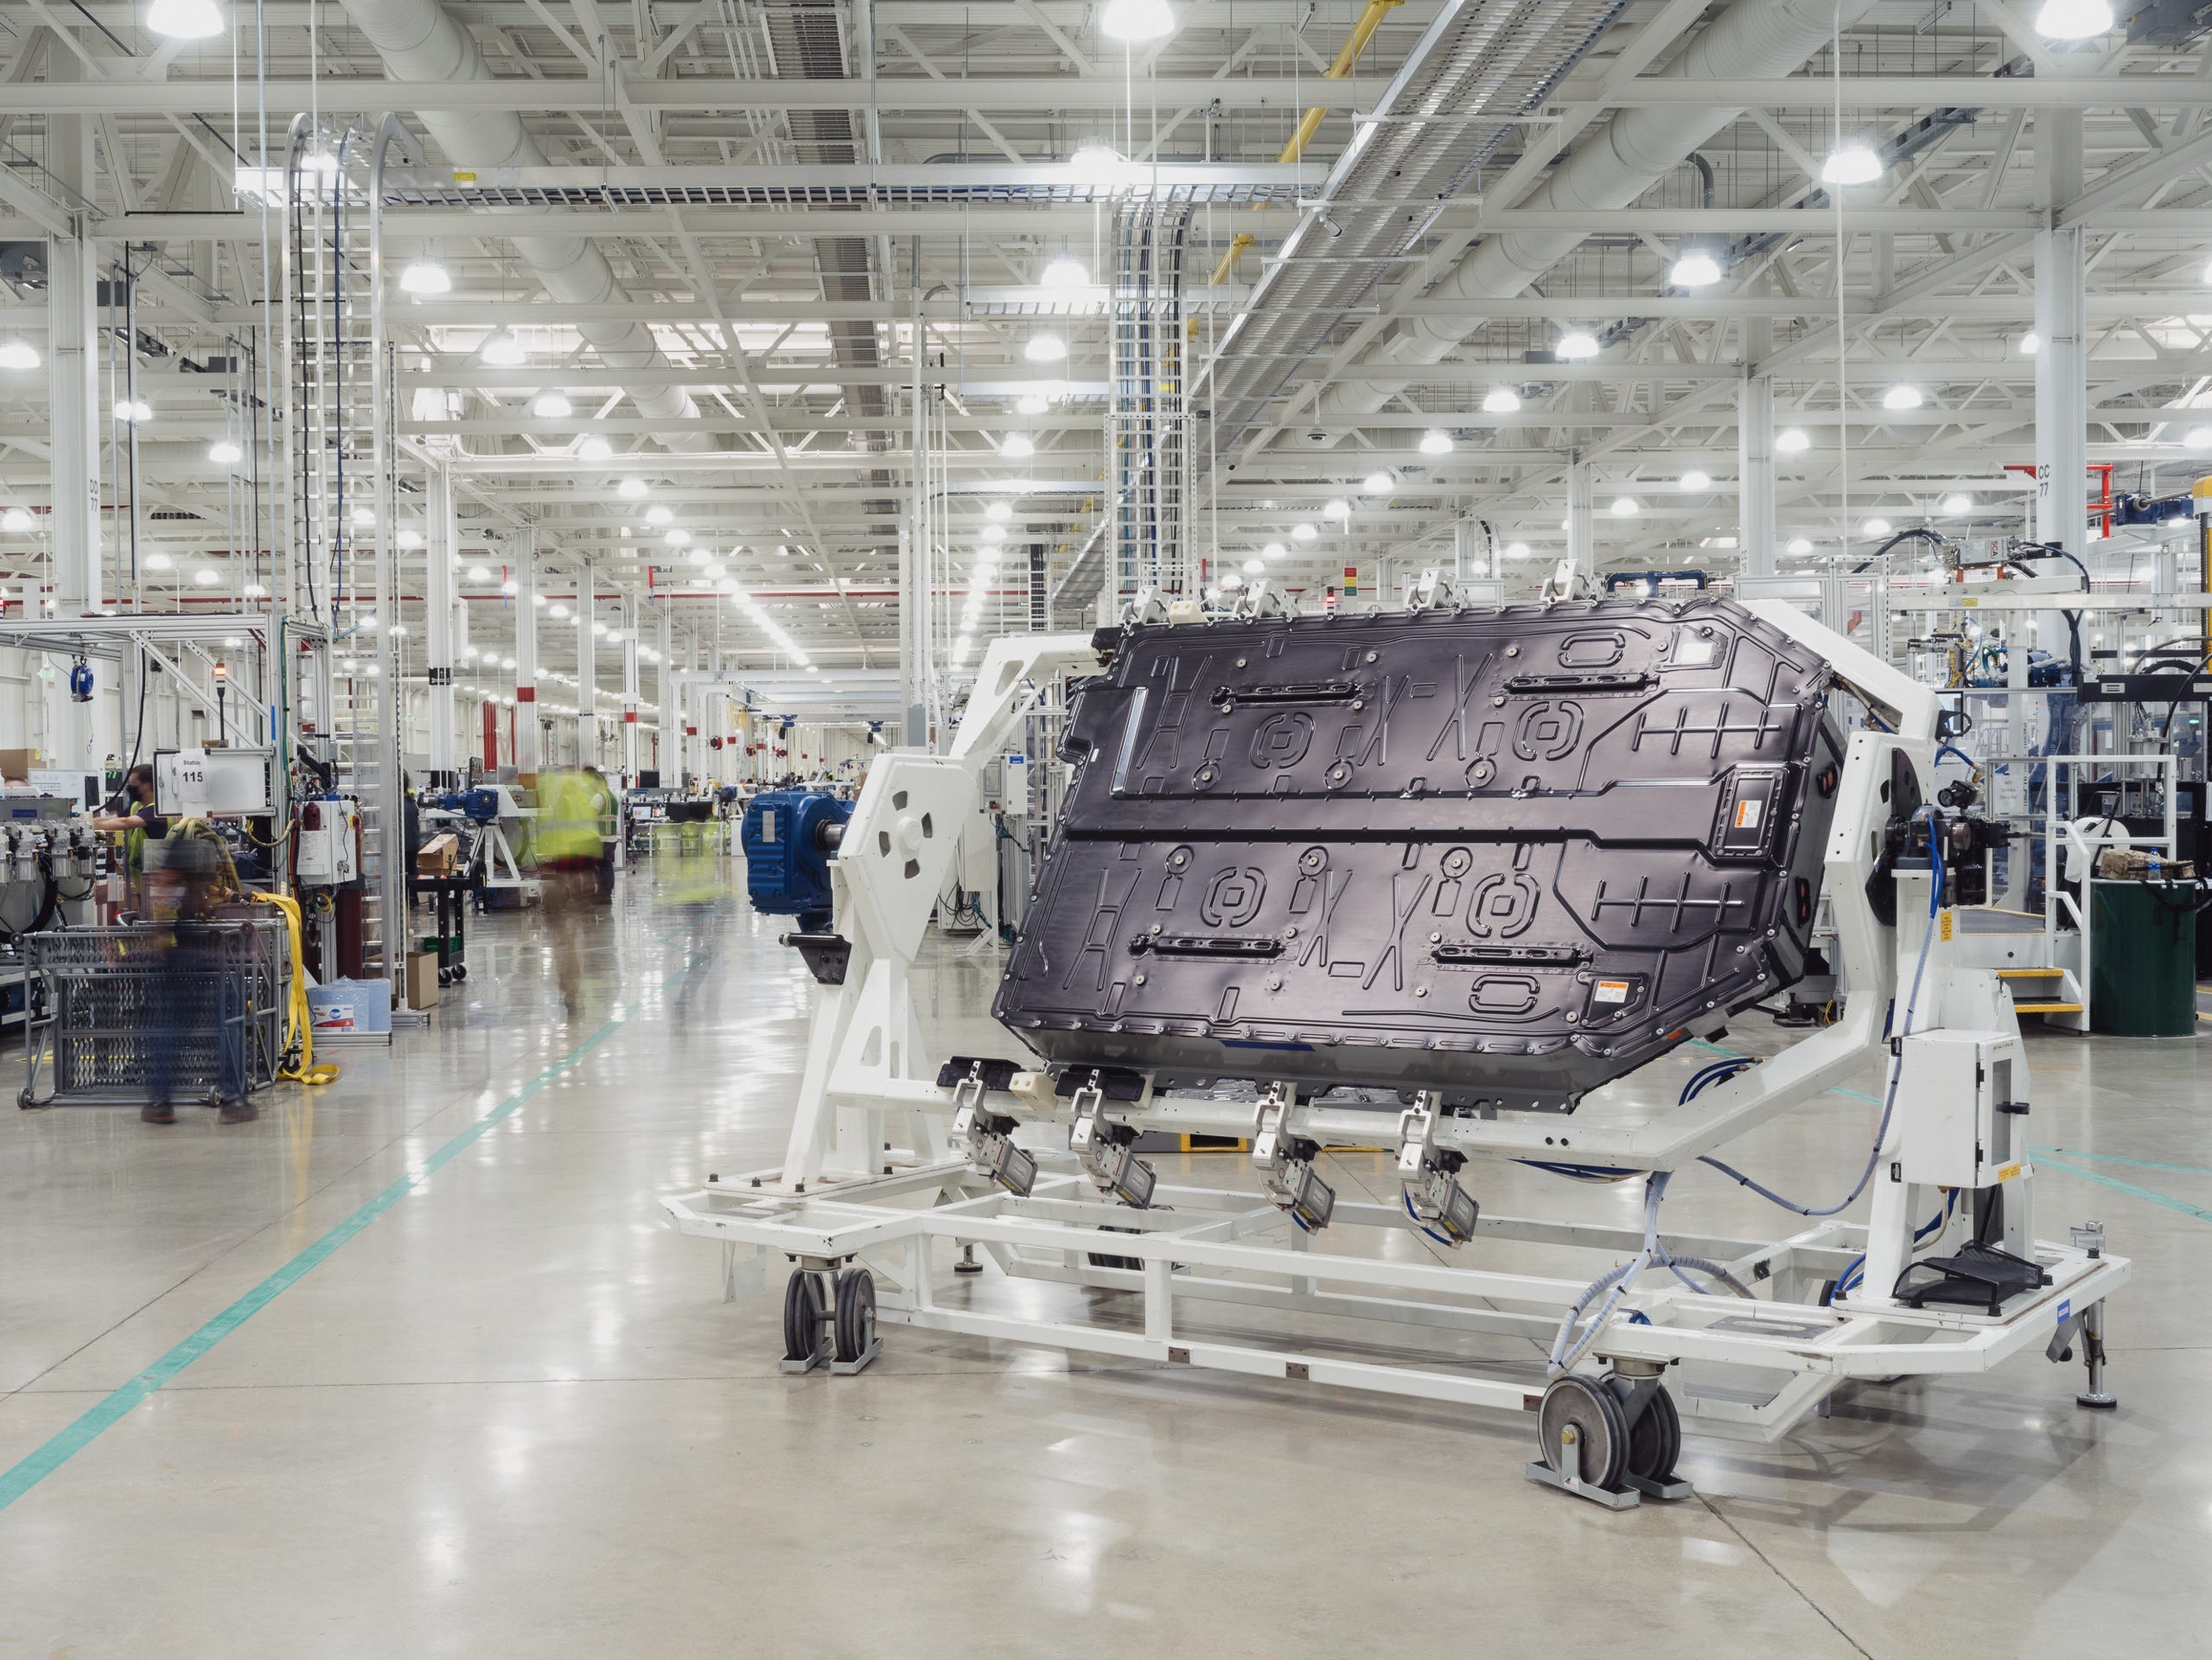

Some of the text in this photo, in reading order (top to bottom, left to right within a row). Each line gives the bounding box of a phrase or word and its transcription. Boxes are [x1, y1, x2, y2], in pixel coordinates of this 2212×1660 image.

[2038, 463, 2049, 480] CC
[90, 479, 99, 495] DD
[2039, 482, 2049, 497] 77
[91, 497, 98, 512] 77
[182, 771, 203, 782] 115
